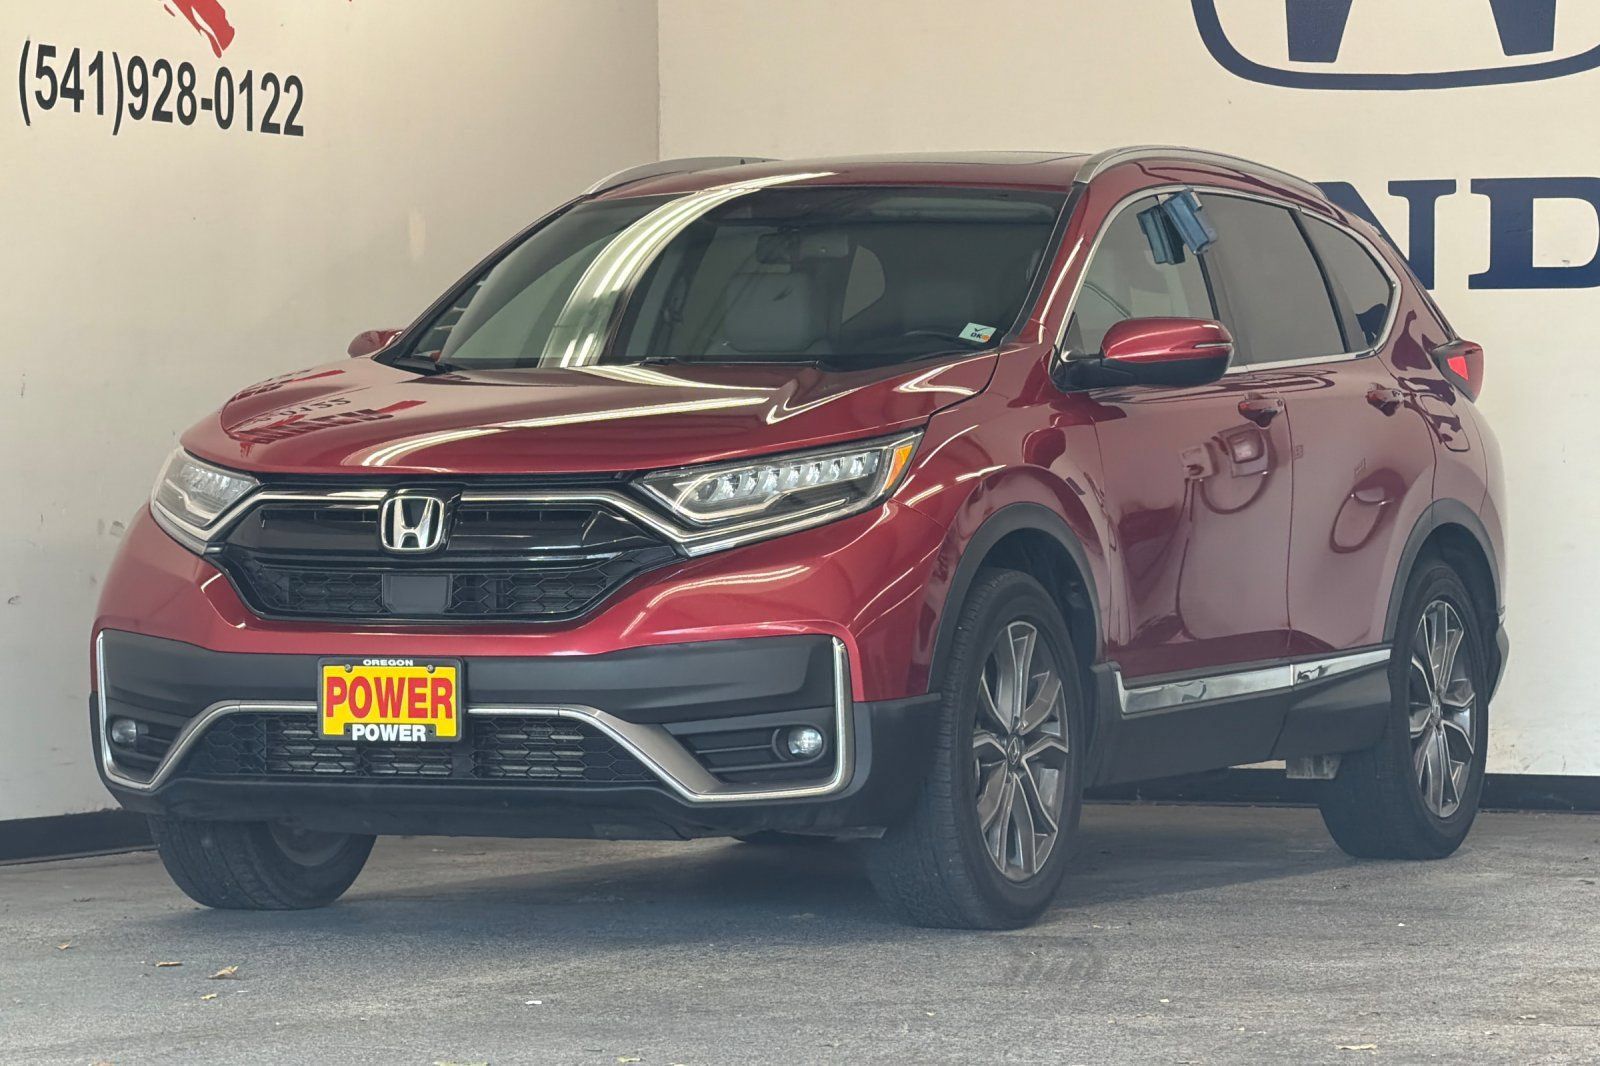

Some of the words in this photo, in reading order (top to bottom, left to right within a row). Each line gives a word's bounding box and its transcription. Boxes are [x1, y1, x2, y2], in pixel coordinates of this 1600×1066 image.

[19, 39, 305, 137] (541)928-0122
[362, 659, 414, 667] OREGON
[325, 676, 454, 719] POWER
[351, 723, 427, 742] POWER
